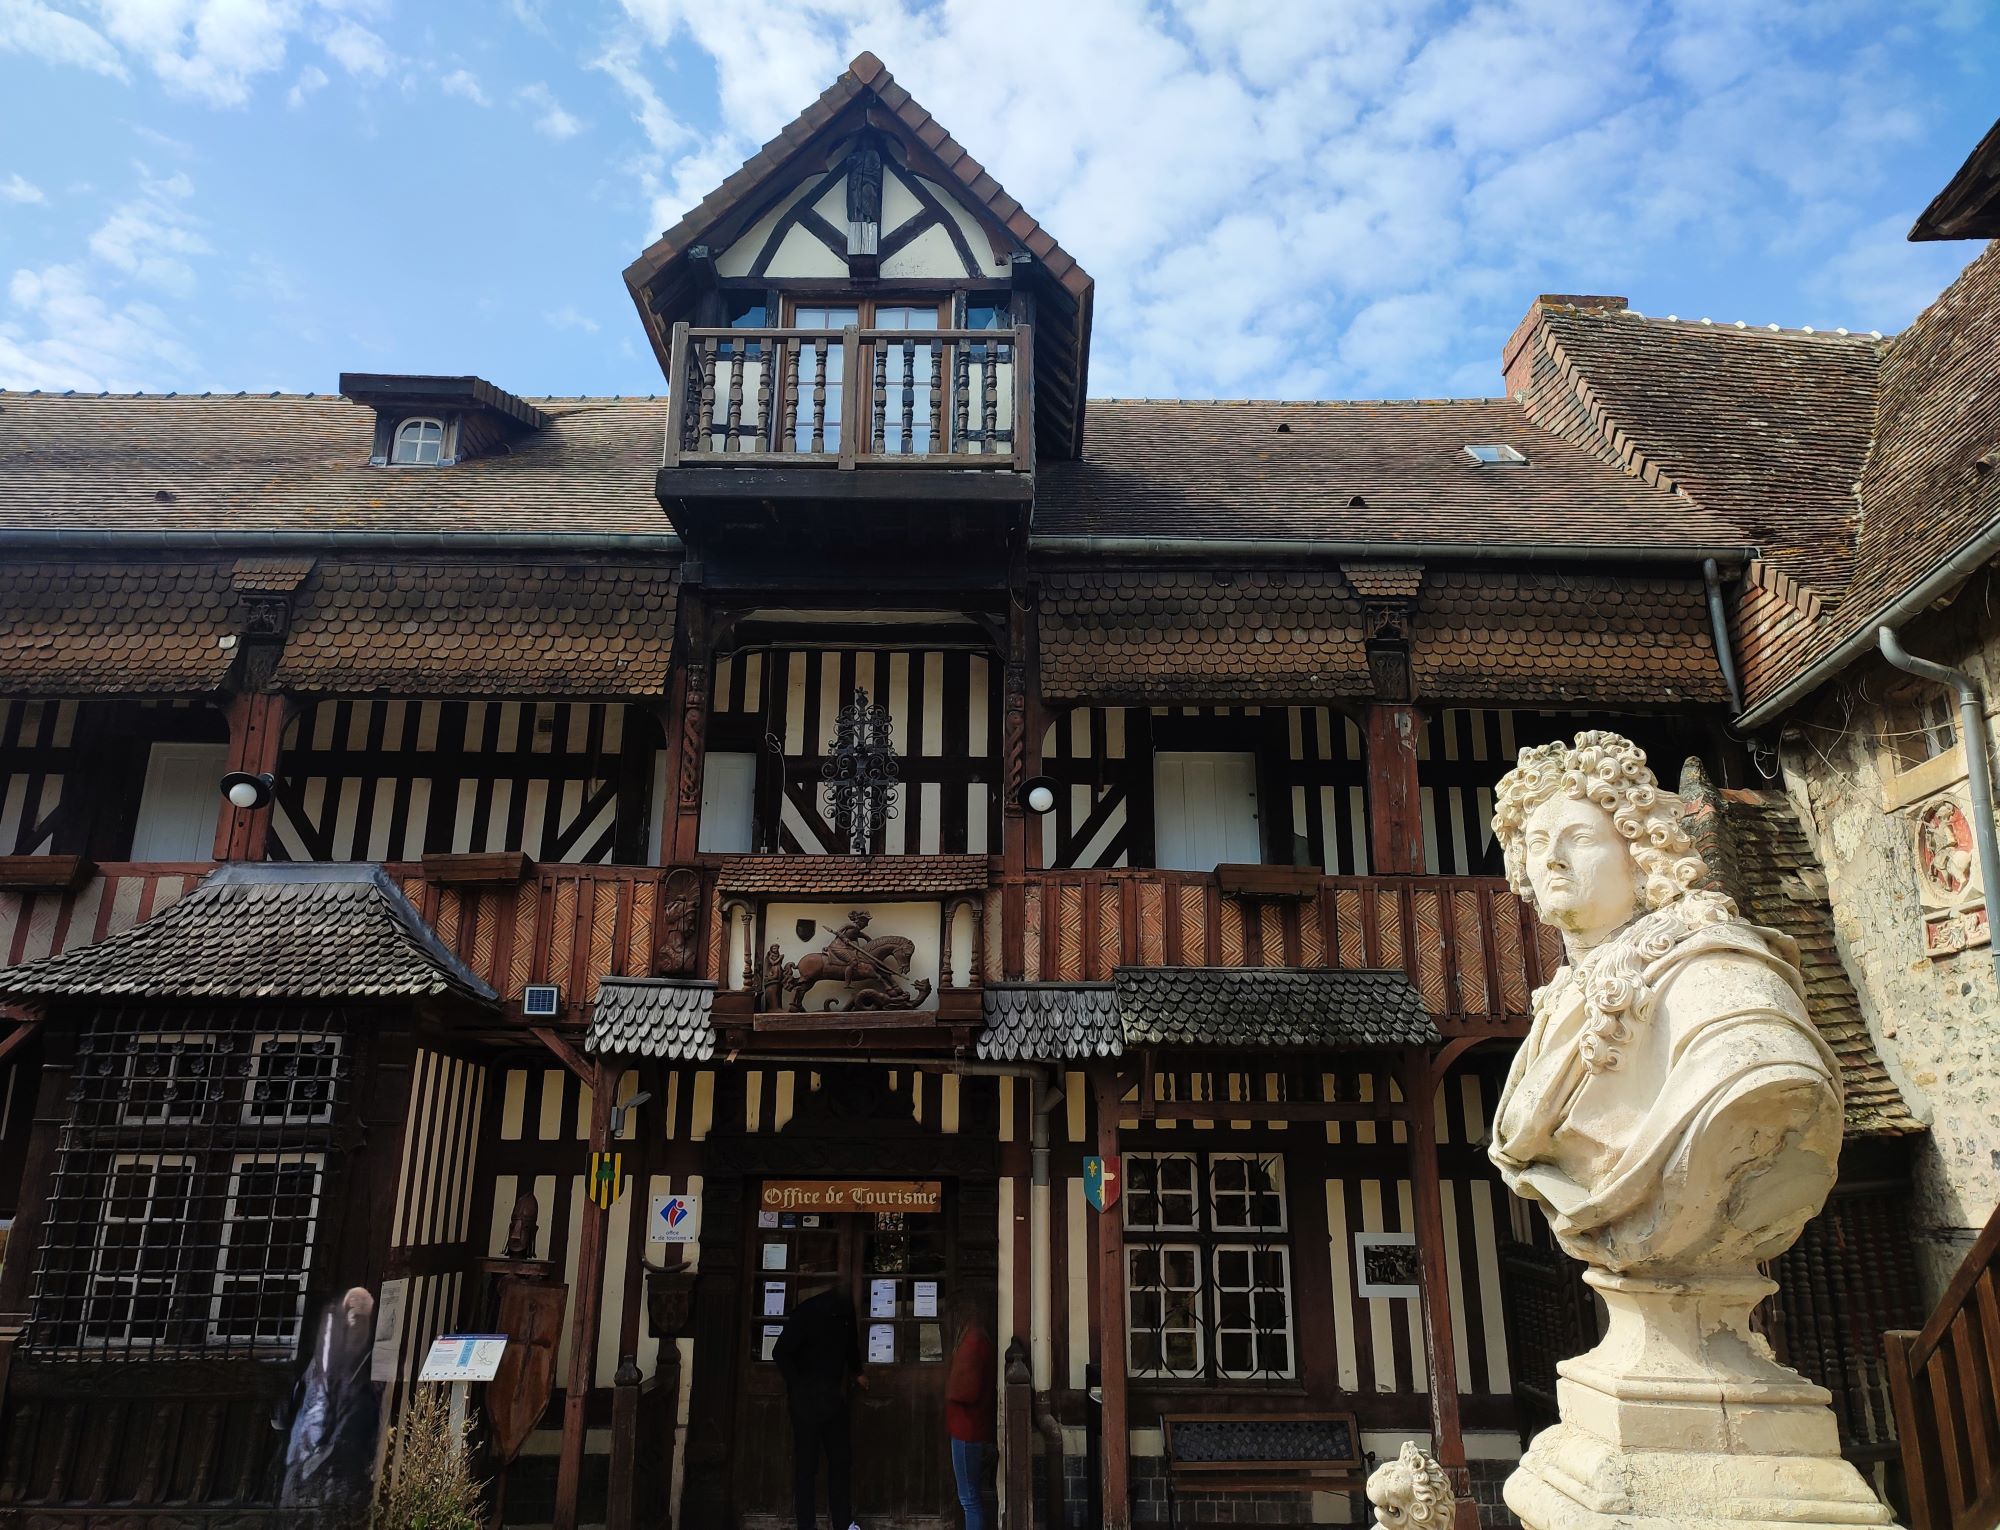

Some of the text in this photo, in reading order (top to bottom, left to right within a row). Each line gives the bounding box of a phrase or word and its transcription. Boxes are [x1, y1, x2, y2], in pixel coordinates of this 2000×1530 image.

[764, 1186, 937, 1208] Office de Tourisme
